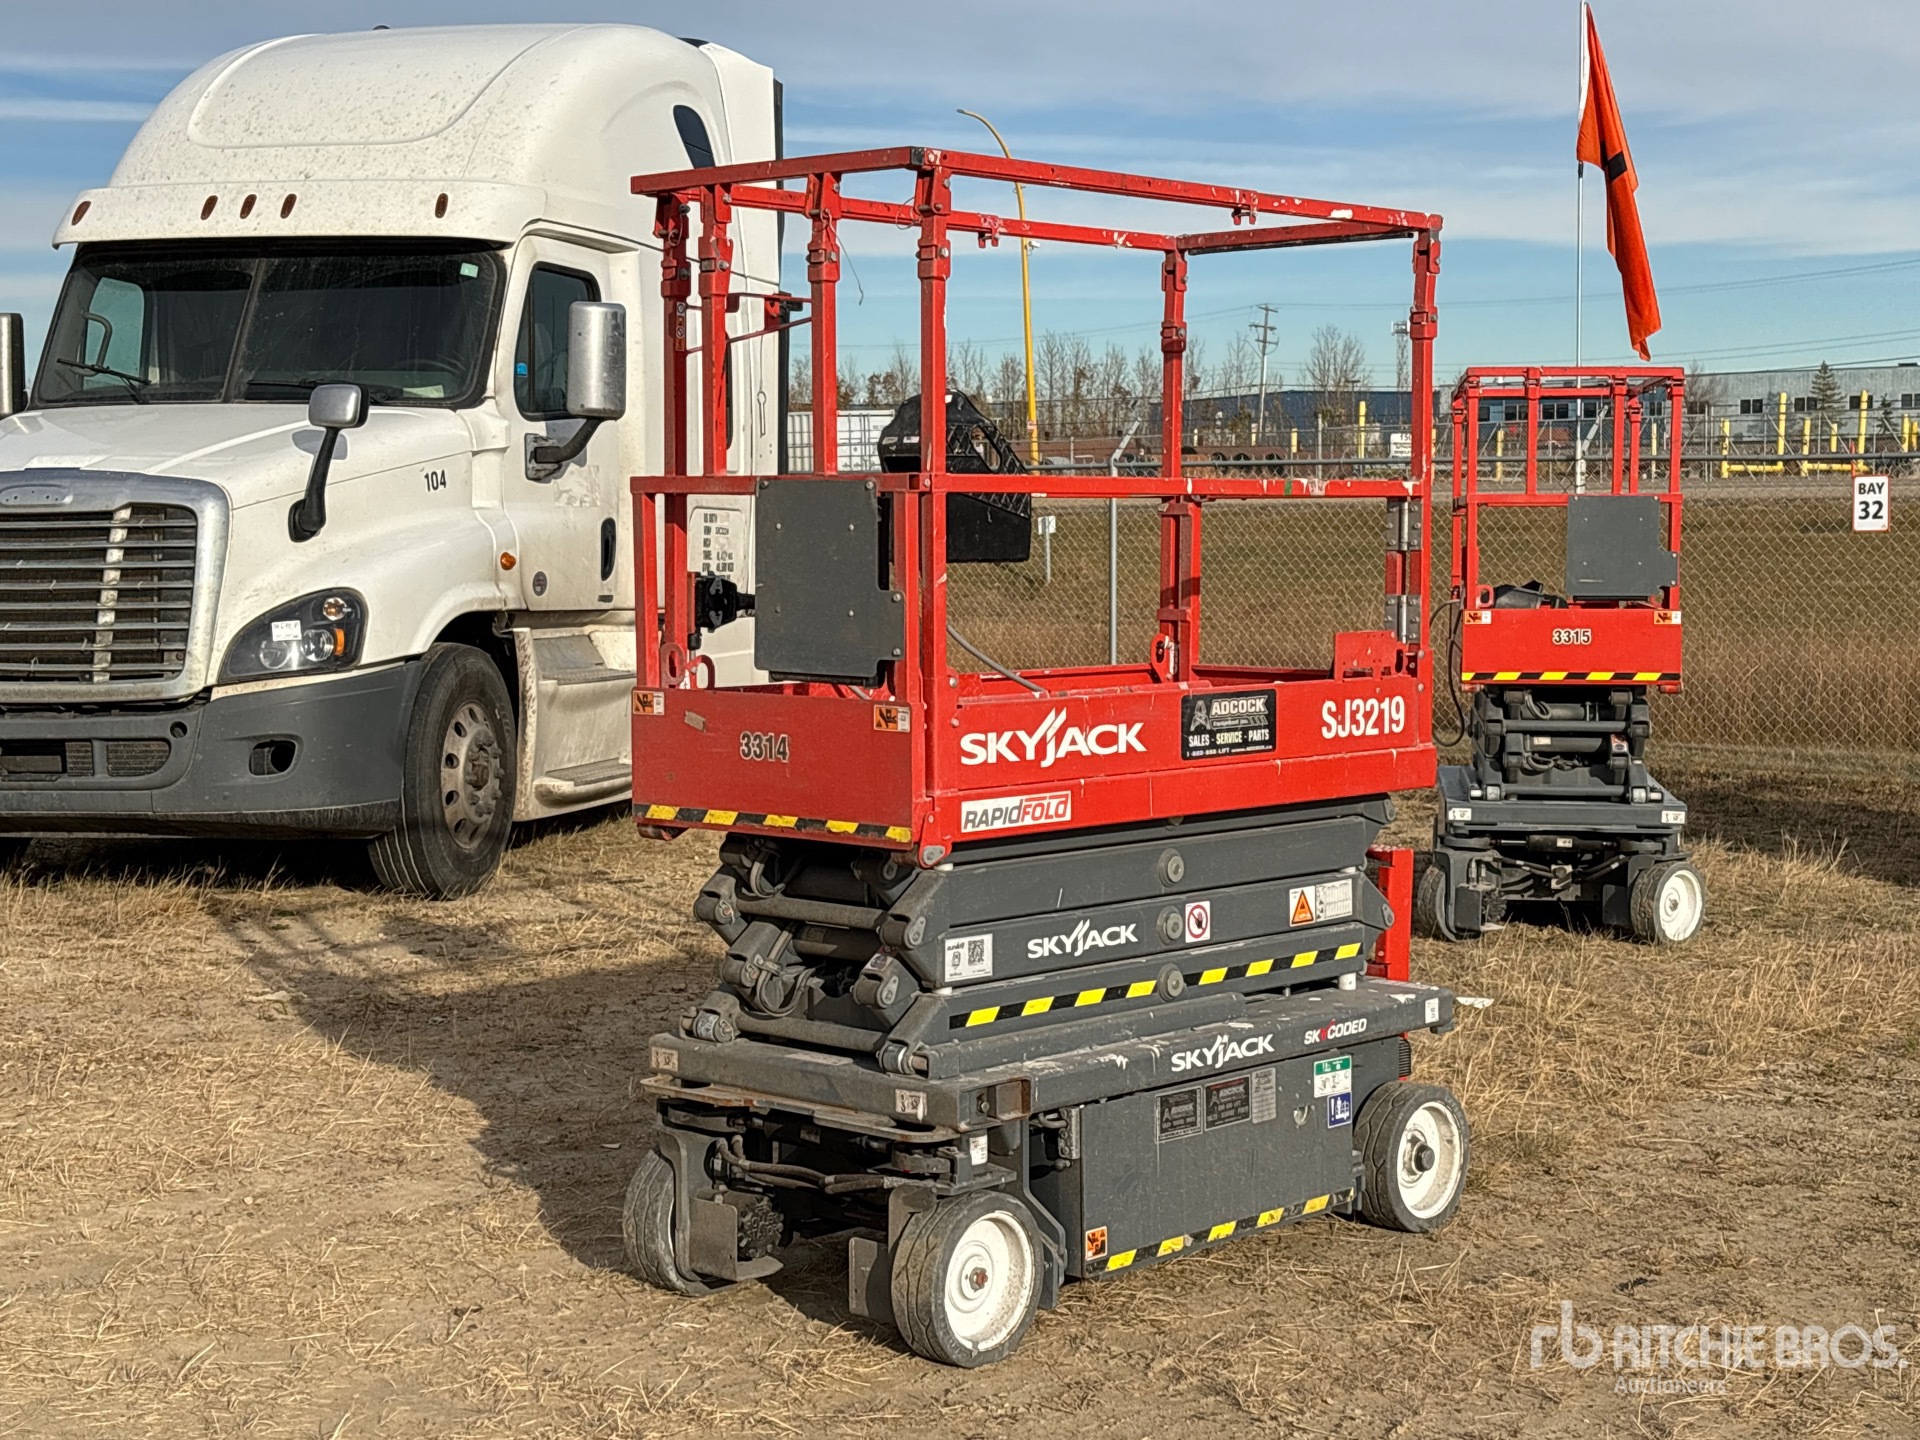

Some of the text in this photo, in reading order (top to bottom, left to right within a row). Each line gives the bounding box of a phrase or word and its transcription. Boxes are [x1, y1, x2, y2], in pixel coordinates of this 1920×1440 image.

[424, 469, 447, 493] 104
[1858, 481, 1886, 496] BAY
[1857, 500, 1885, 520] 32
[1552, 628, 1592, 645] 3315
[1211, 697, 1266, 716] ADCOCK
[1321, 695, 1405, 740] SJ3219
[739, 730, 790, 764] 3314
[960, 707, 1147, 768] SKYJACK
[1188, 729, 1270, 747] SALES SERVICE PARTS
[1027, 918, 1139, 960] SKYJACK
[1303, 1018, 1367, 1045] SKYCODED
[1171, 1034, 1276, 1073] SKYJACK
